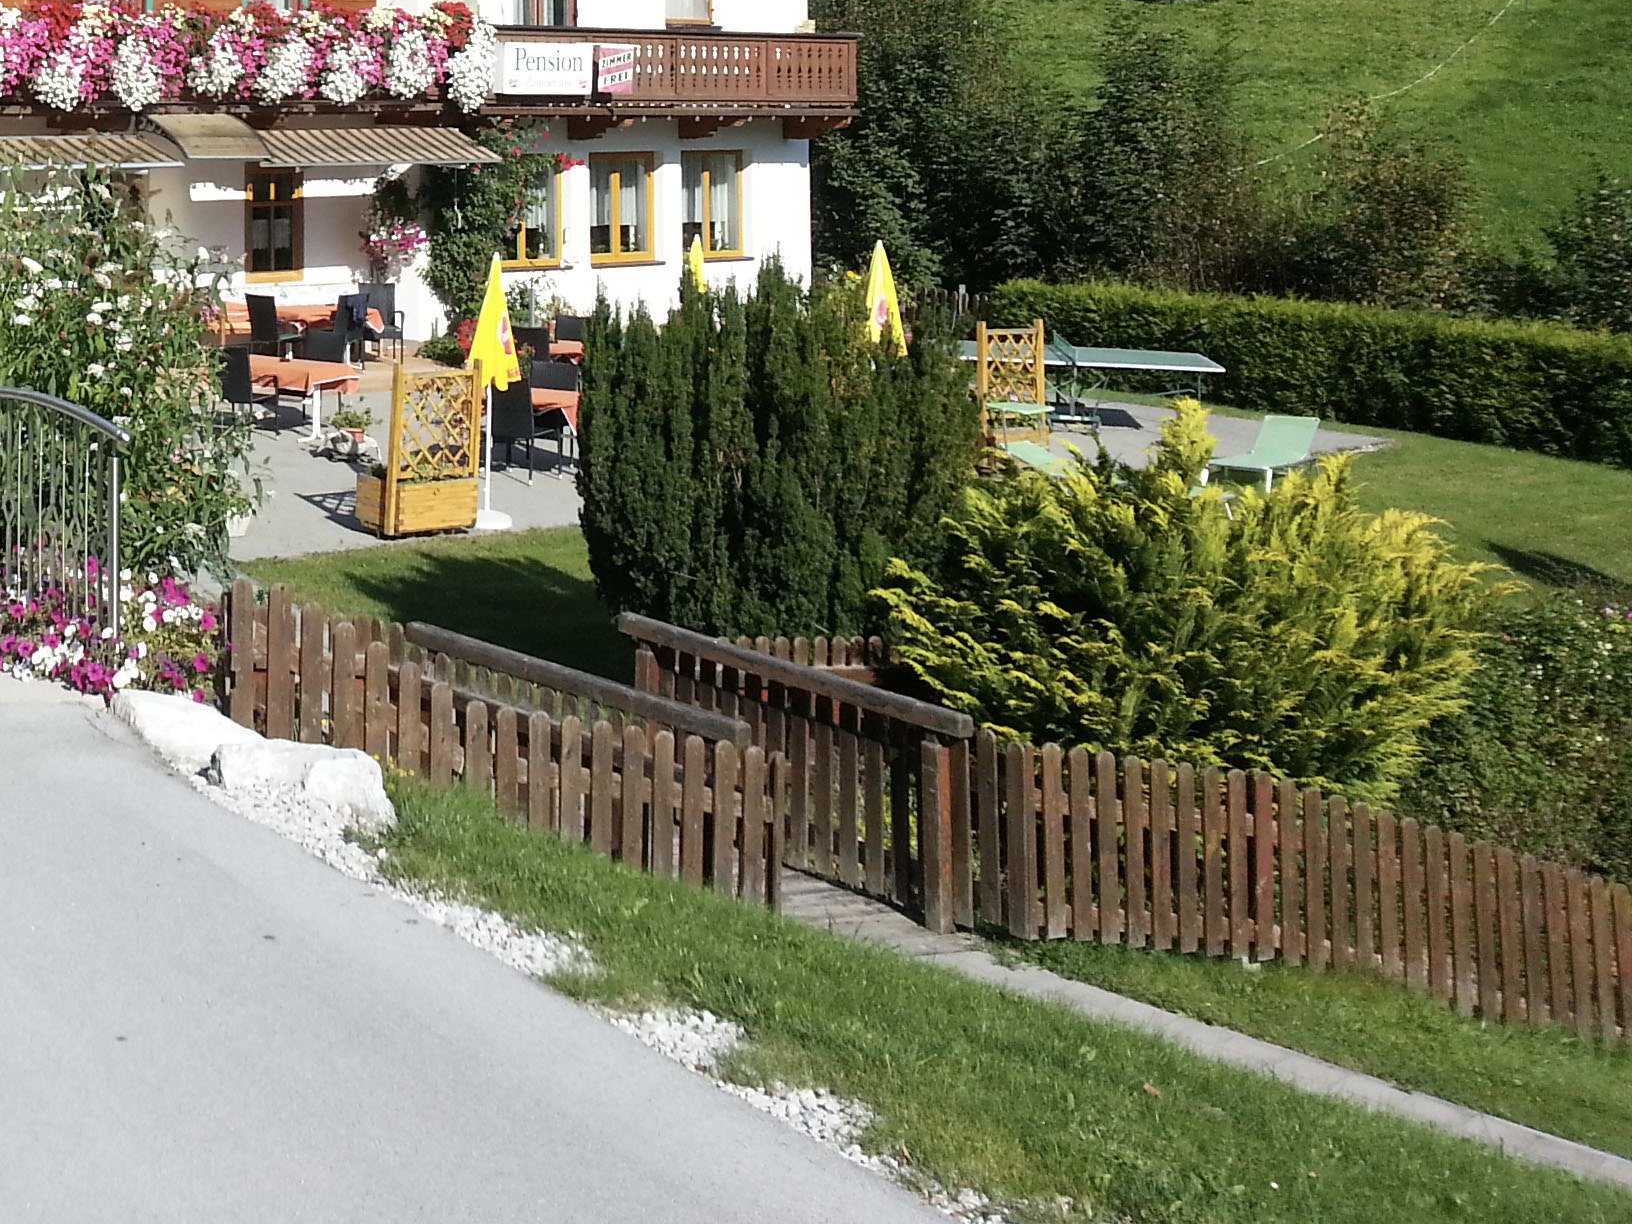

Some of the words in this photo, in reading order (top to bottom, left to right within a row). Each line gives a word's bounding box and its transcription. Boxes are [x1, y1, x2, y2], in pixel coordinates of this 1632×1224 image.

[514, 47, 583, 72] Pension
[601, 52, 632, 68] ZIMMER
[603, 74, 629, 85] FREI
